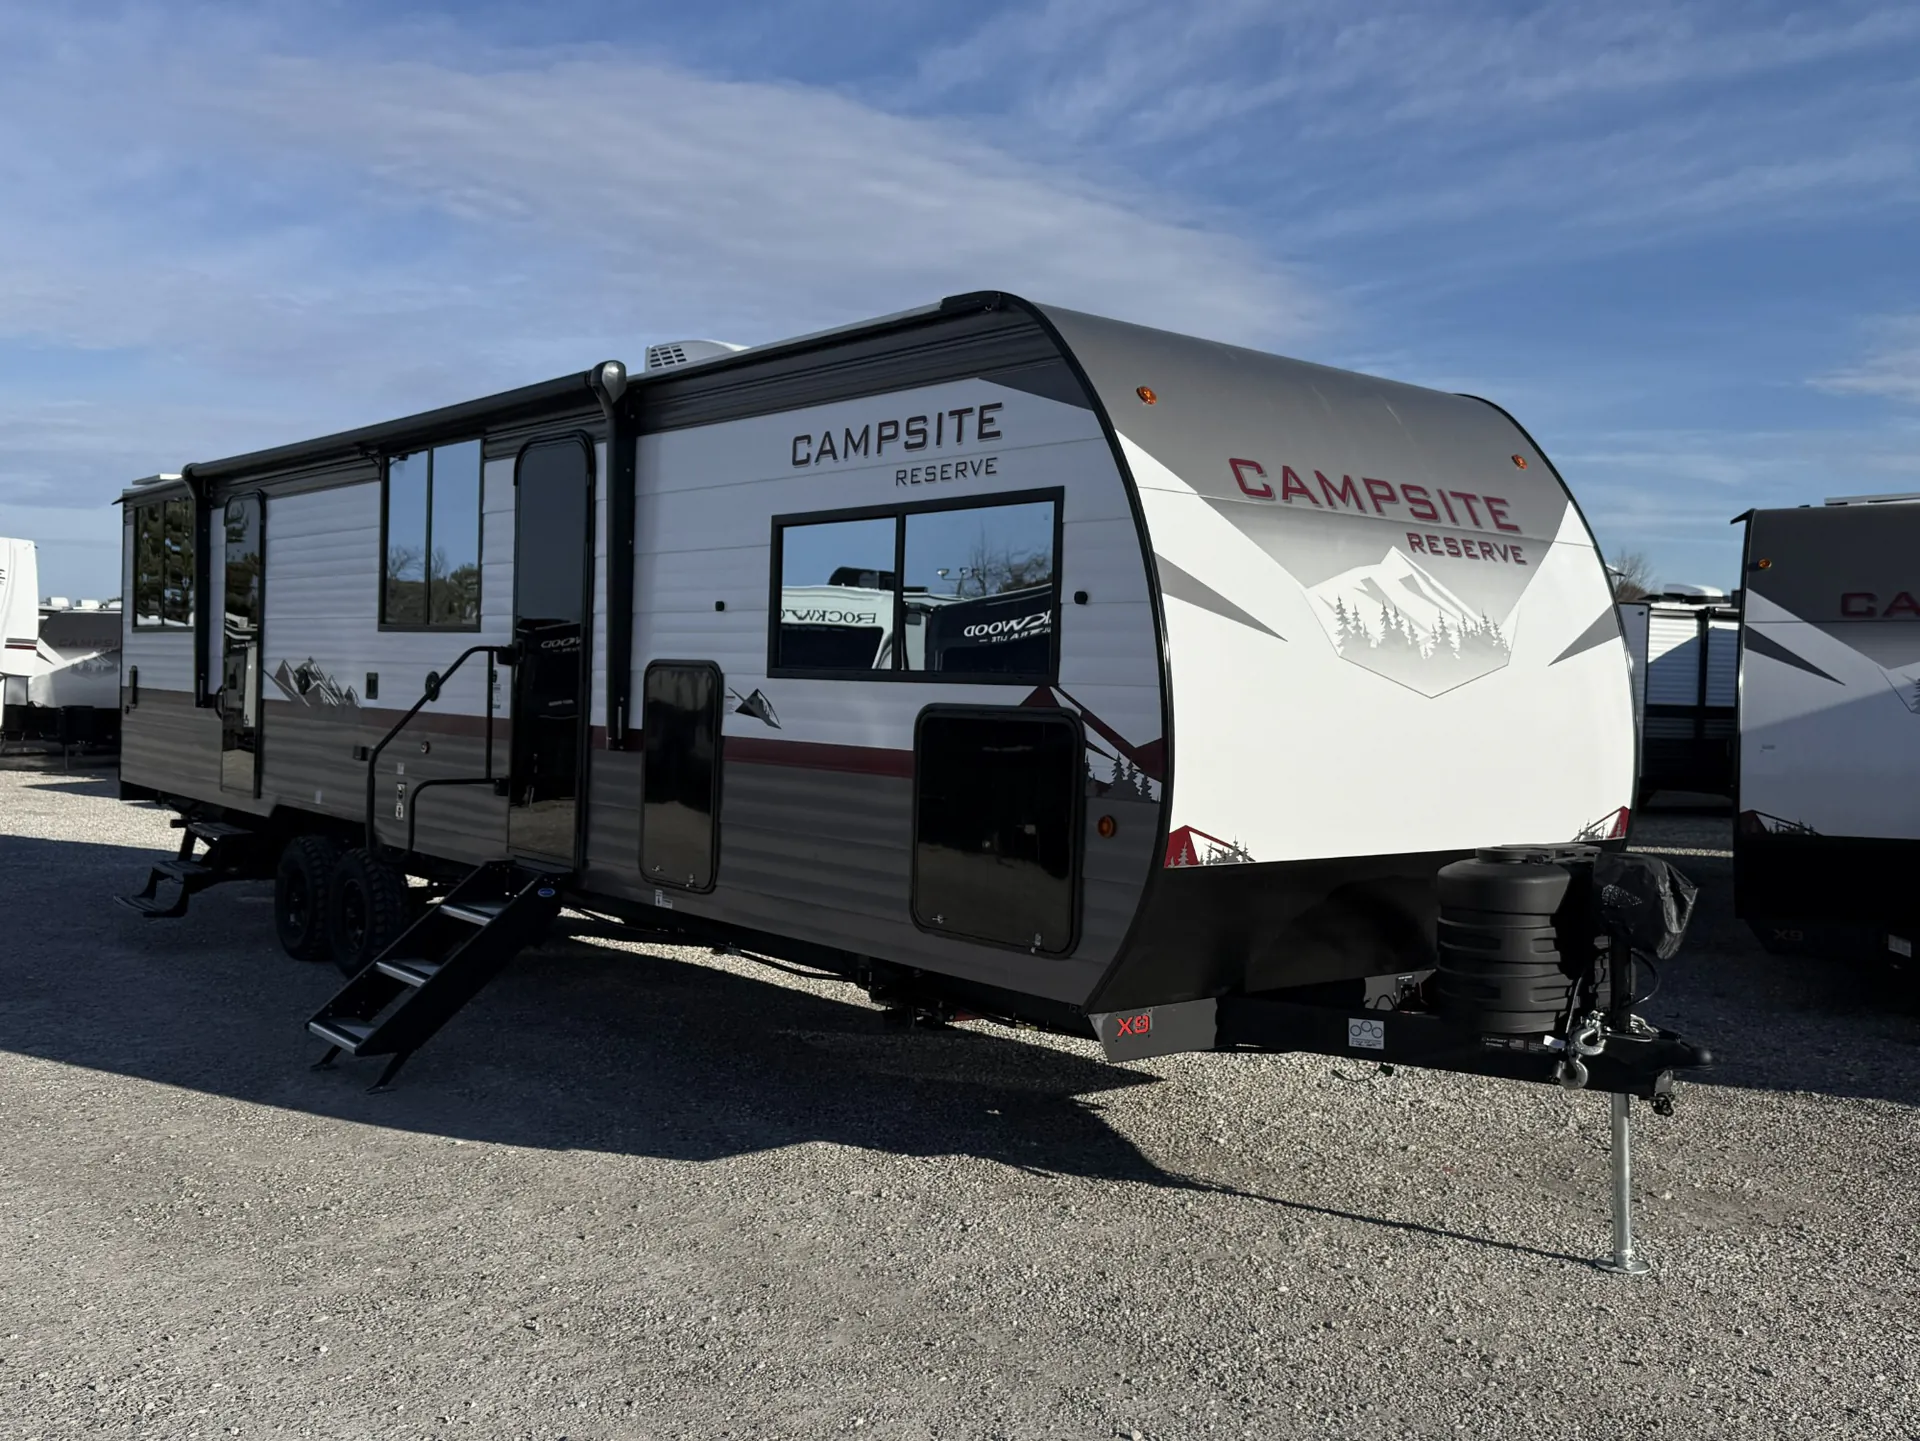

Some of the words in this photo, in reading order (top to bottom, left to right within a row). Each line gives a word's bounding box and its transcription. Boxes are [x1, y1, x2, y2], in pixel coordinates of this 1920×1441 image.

[791, 402, 1003, 467] CAMPSITE
[895, 457, 998, 487] RESERVE
[1228, 457, 1522, 533] CAMPSITE
[1406, 531, 1528, 566] RESERVE
[1116, 1014, 1150, 1037] X9
